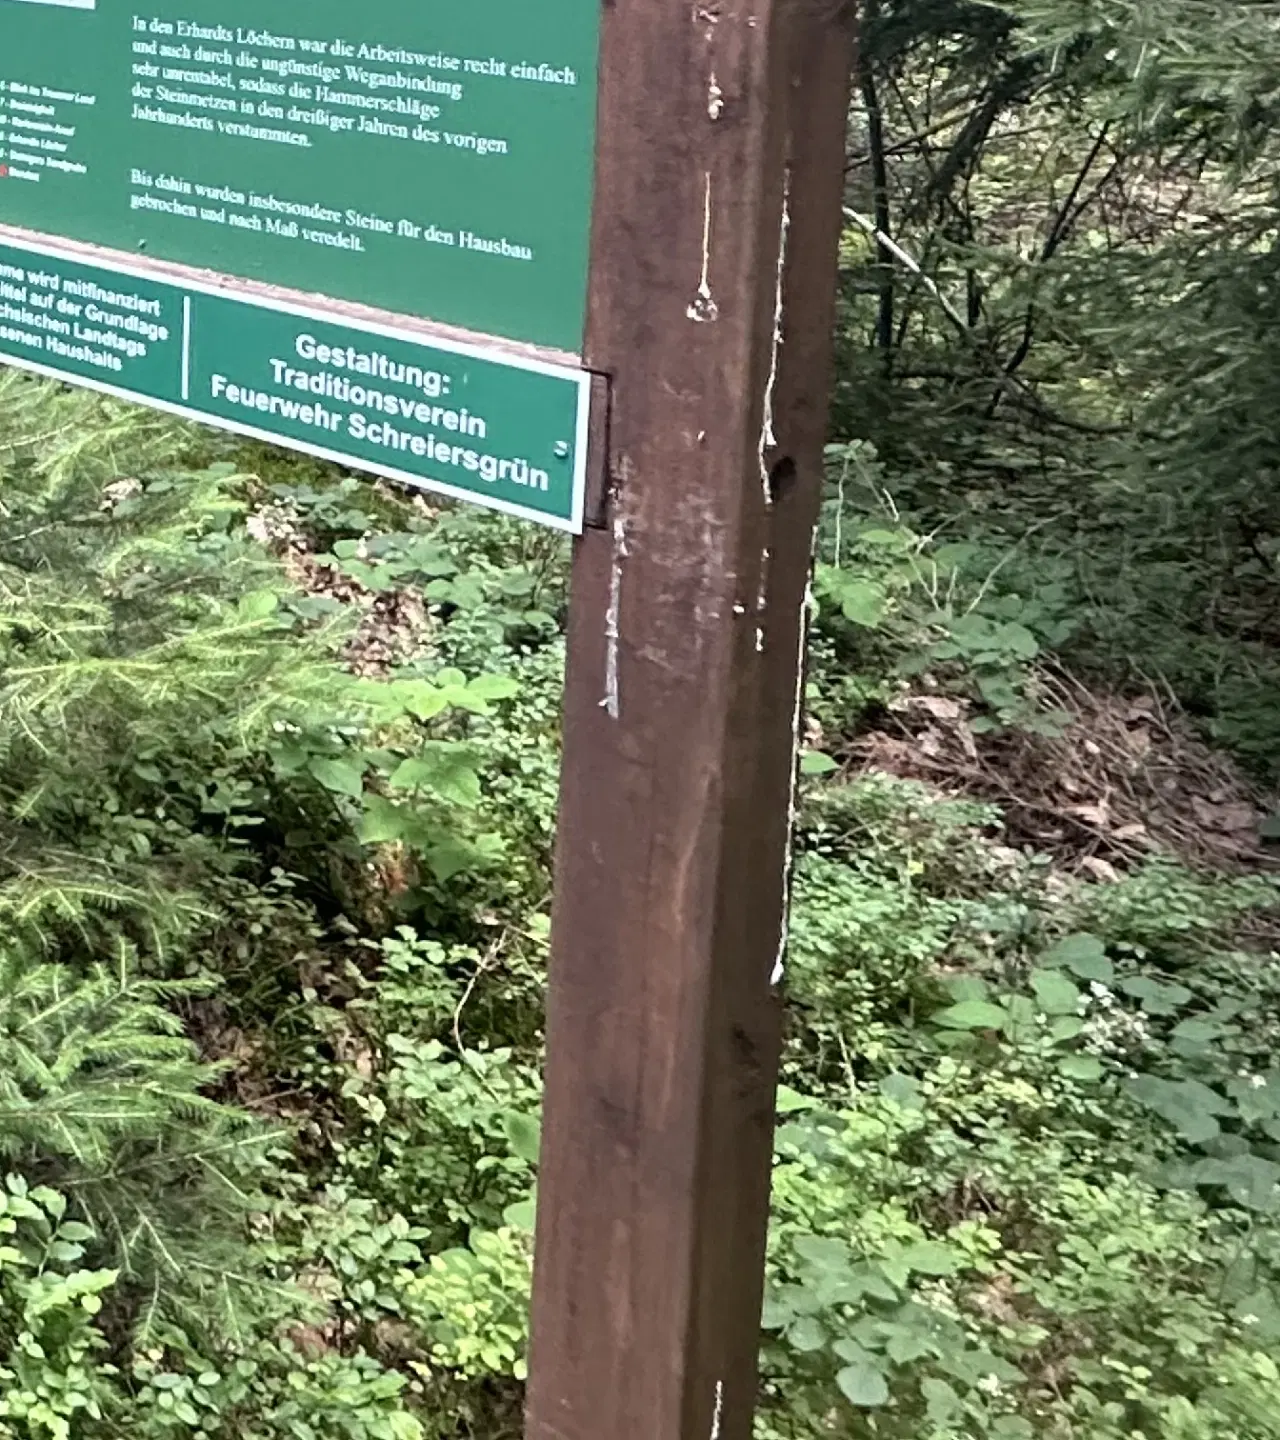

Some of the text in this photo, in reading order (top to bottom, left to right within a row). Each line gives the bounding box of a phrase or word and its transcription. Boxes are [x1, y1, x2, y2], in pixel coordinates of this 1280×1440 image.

[131, 39, 462, 100] und auch durch die ungünstige Weganbindung
[132, 14, 576, 85] In den Erhardts Löchern war die Arbeitsweise recht einfach
[130, 81, 507, 155] der Steinmetzen in den dreißiger Jahren des vorigen
[131, 60, 439, 121] sehr unrentabel, sodass die Hammerschläge
[130, 102, 312, 147] Jahrhunderts verstummten.
[129, 192, 365, 251] gebrochen und nach Maß veredelt.
[130, 167, 532, 260] Bis dahin wurden insbesondere Steine für den Hausbau
[27, 271, 60, 291] wird
[63, 279, 161, 317] mitfinanziert
[28, 291, 55, 309] auf
[55, 296, 83, 317] der
[84, 302, 169, 341] Grundlage
[45, 334, 122, 371] Haushalts
[72, 321, 146, 357] Landtags
[295, 333, 451, 397] Gestaltung:
[268, 357, 486, 438] Traditionsverein
[211, 373, 548, 491] Feuerwehr Schreiersgrün
